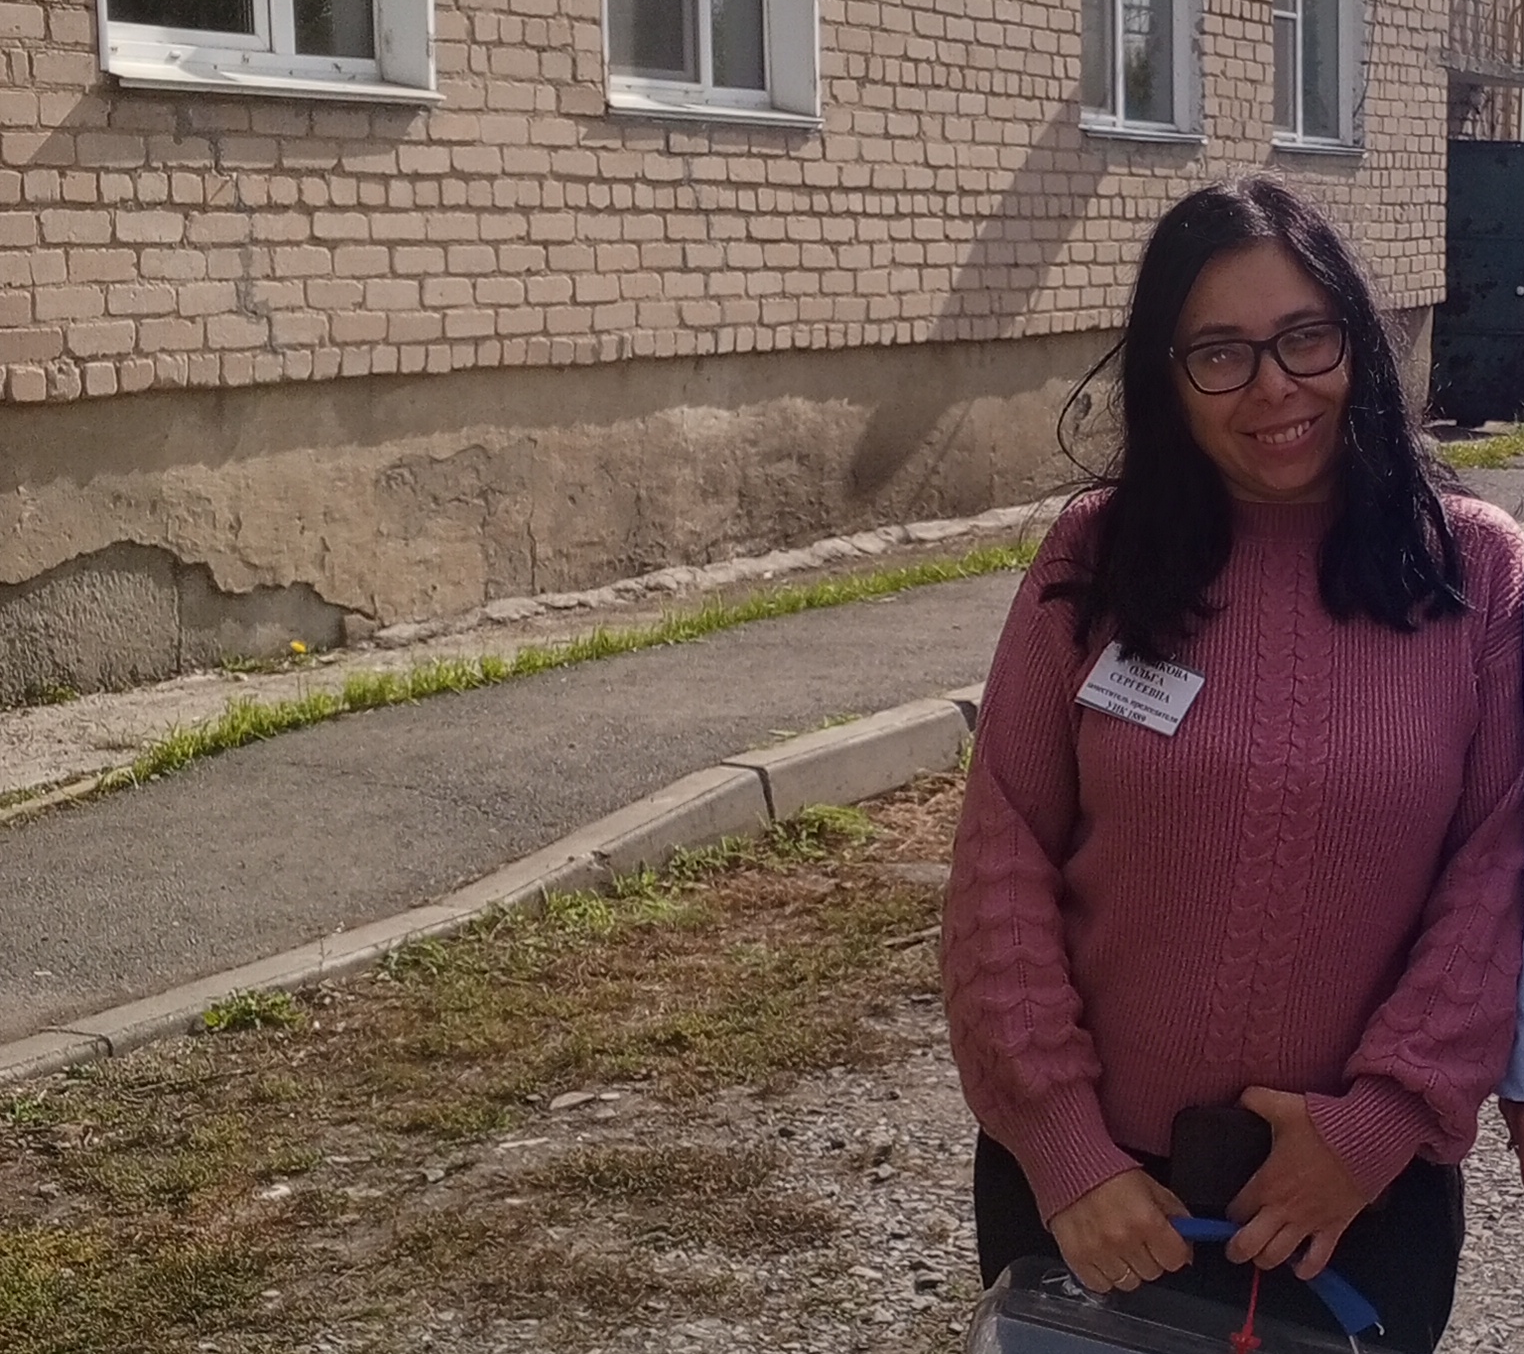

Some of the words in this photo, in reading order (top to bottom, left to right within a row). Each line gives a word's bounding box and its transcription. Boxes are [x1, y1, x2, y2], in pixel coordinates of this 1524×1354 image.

[1129, 665, 1164, 687] ОЛЬГА
[1109, 672, 1171, 704] СЕРГЕЕВНА
[1105, 700, 1128, 715] УИК
